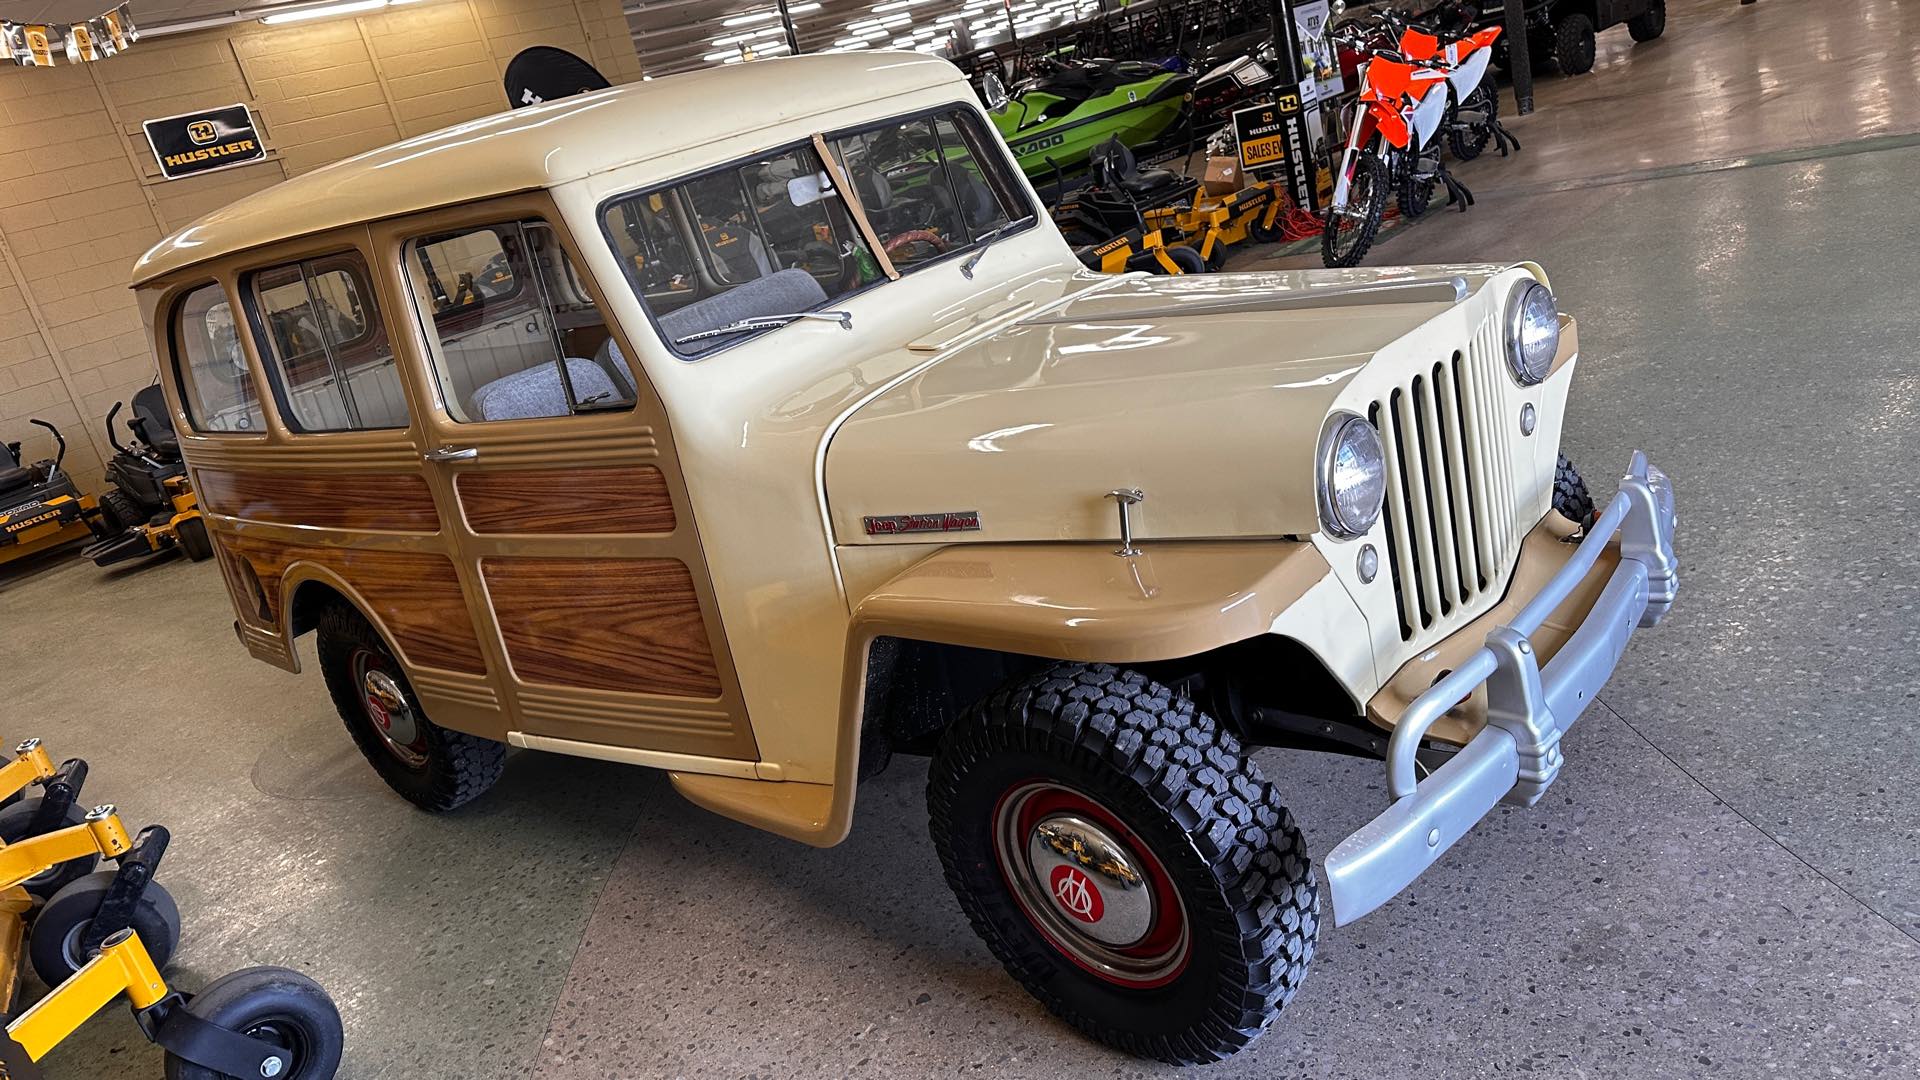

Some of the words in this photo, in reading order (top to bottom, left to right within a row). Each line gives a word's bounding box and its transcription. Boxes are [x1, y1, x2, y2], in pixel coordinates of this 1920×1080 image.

[164, 139, 255, 167] HUSTLER
[1246, 142, 1272, 161] SALES
[1286, 116, 1311, 213] HUSTLER
[1238, 193, 1267, 212] HUSTLER
[1093, 236, 1129, 256] HUSTLER
[5, 509, 62, 533] HUSTLER
[900, 515, 941, 531] Station
[943, 513, 978, 532] Wagon
